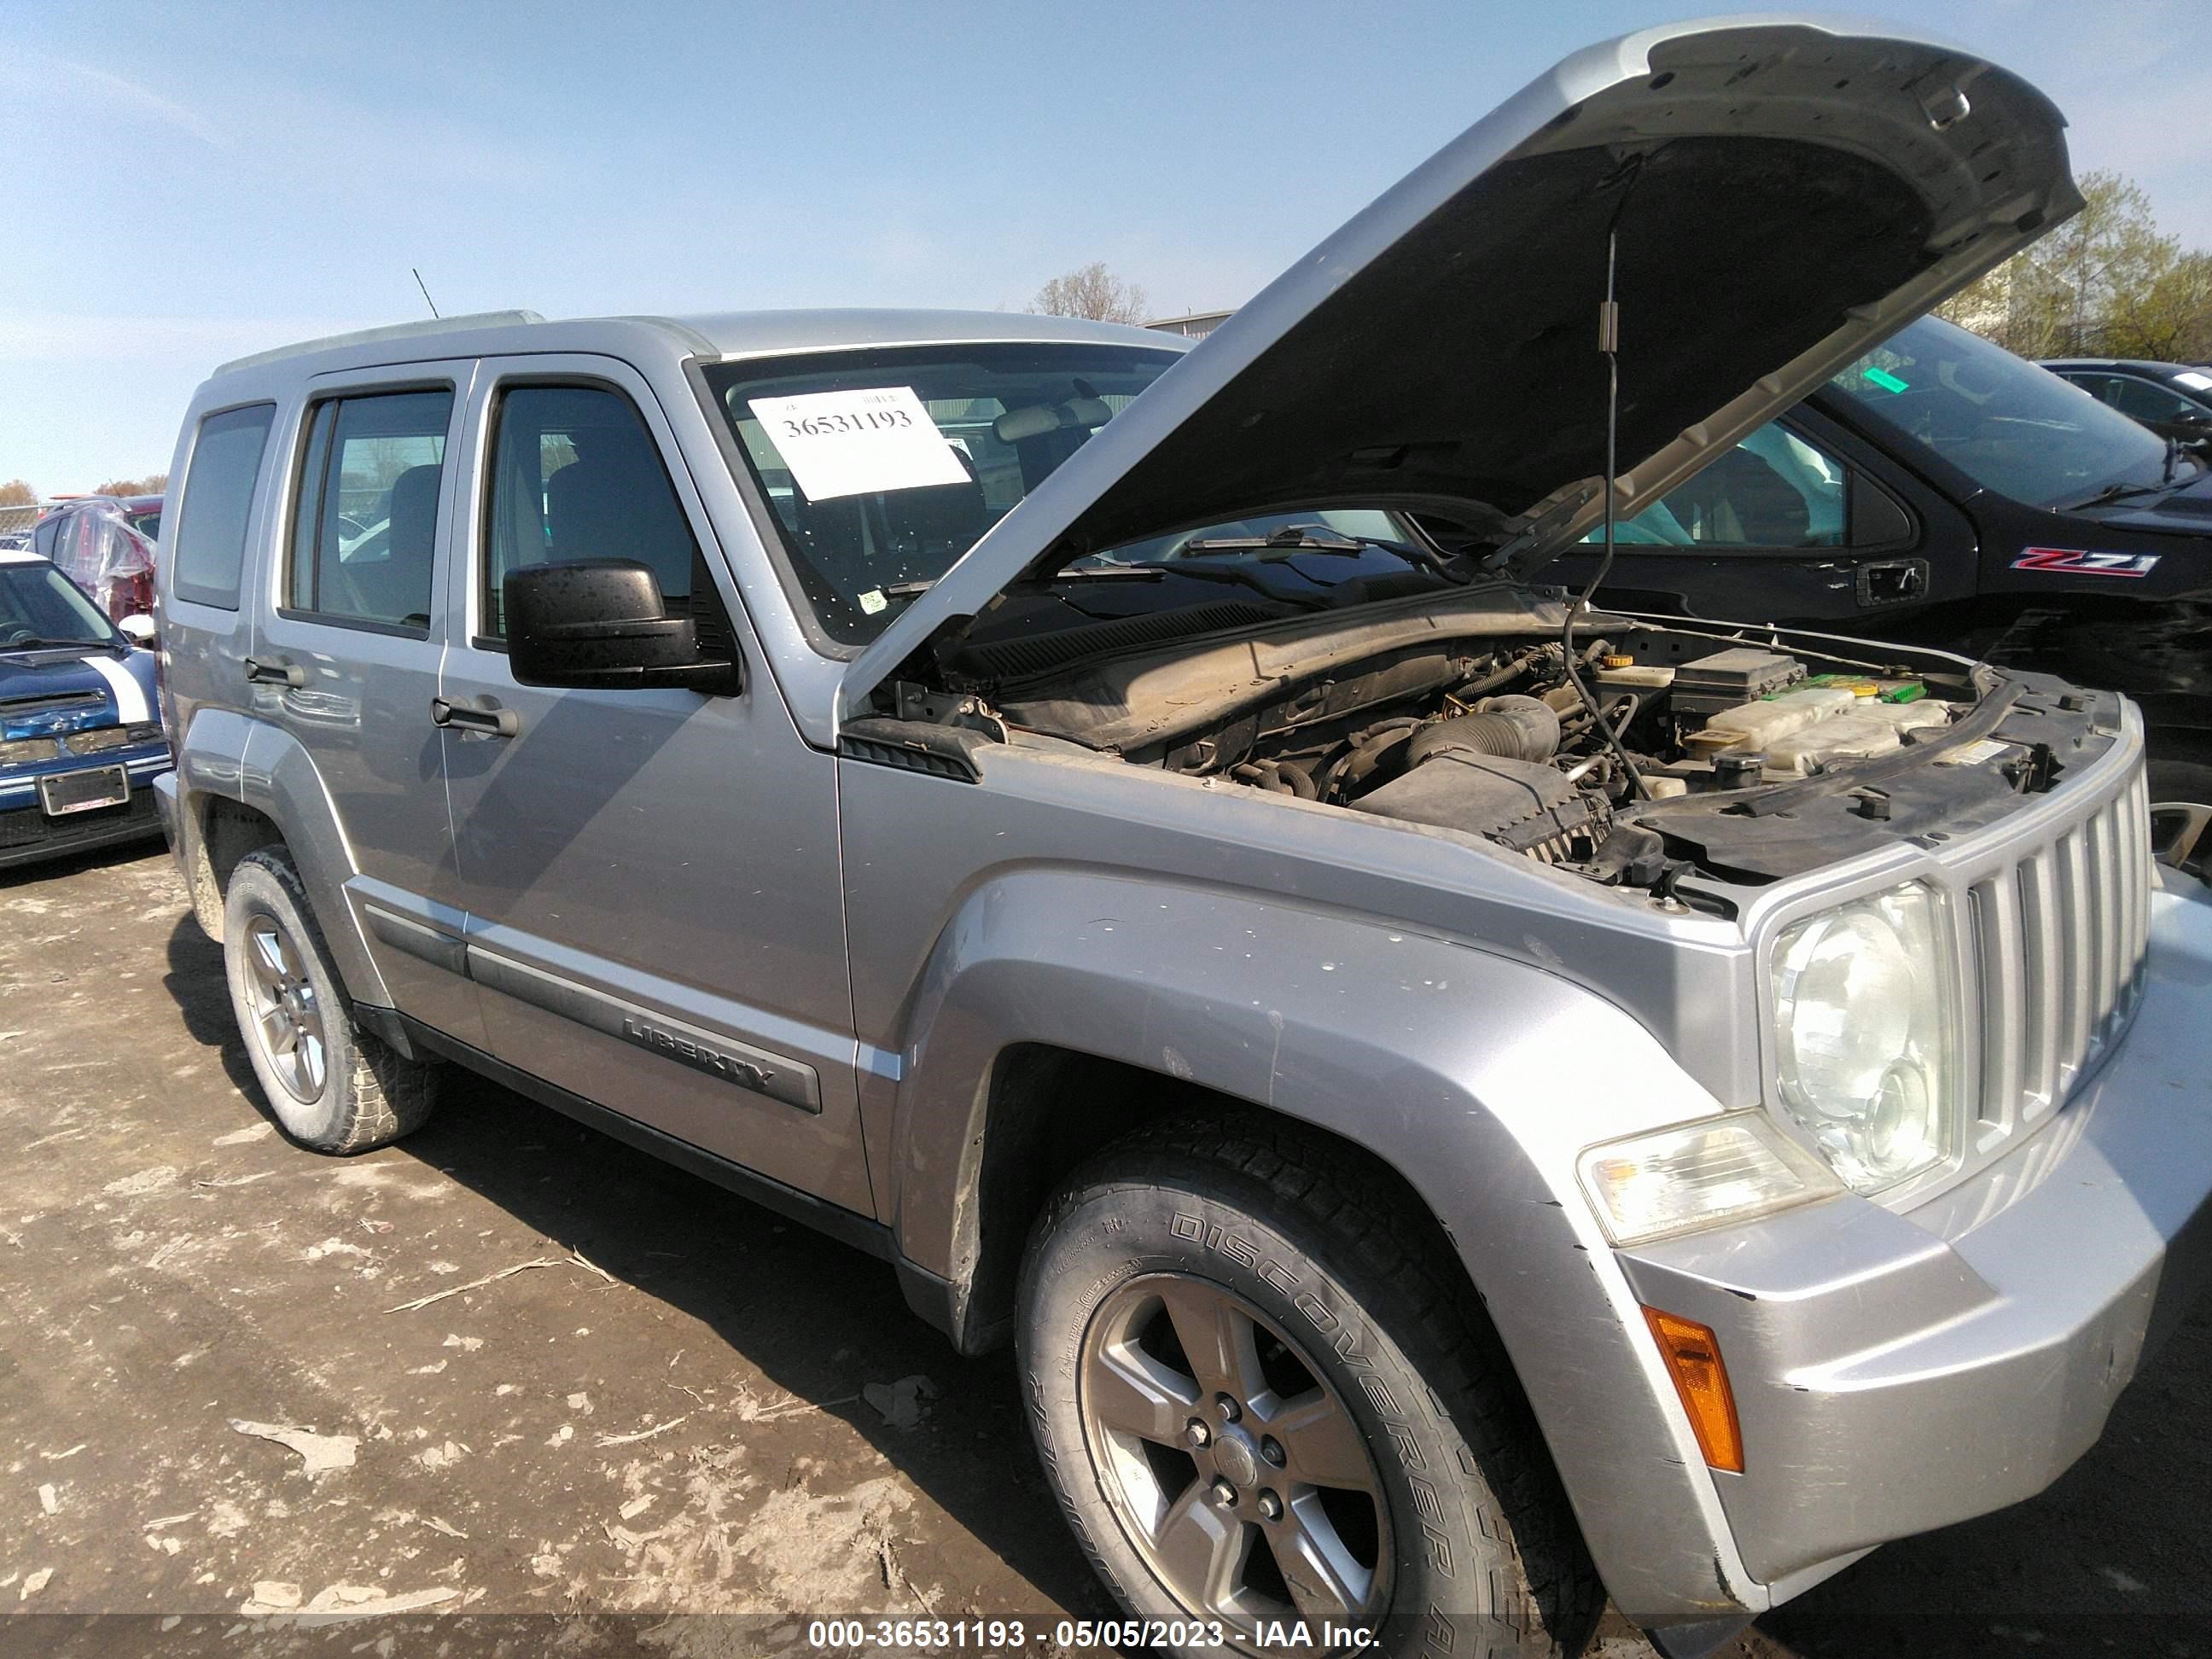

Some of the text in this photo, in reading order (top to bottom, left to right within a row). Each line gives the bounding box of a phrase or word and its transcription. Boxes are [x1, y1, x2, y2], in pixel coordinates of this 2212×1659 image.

[782, 410, 912, 437] 36531193
[2009, 546, 2163, 578] Z71
[622, 1018, 776, 1086] LIBERTY
[1170, 1211, 1455, 1579] DISCOVERER
